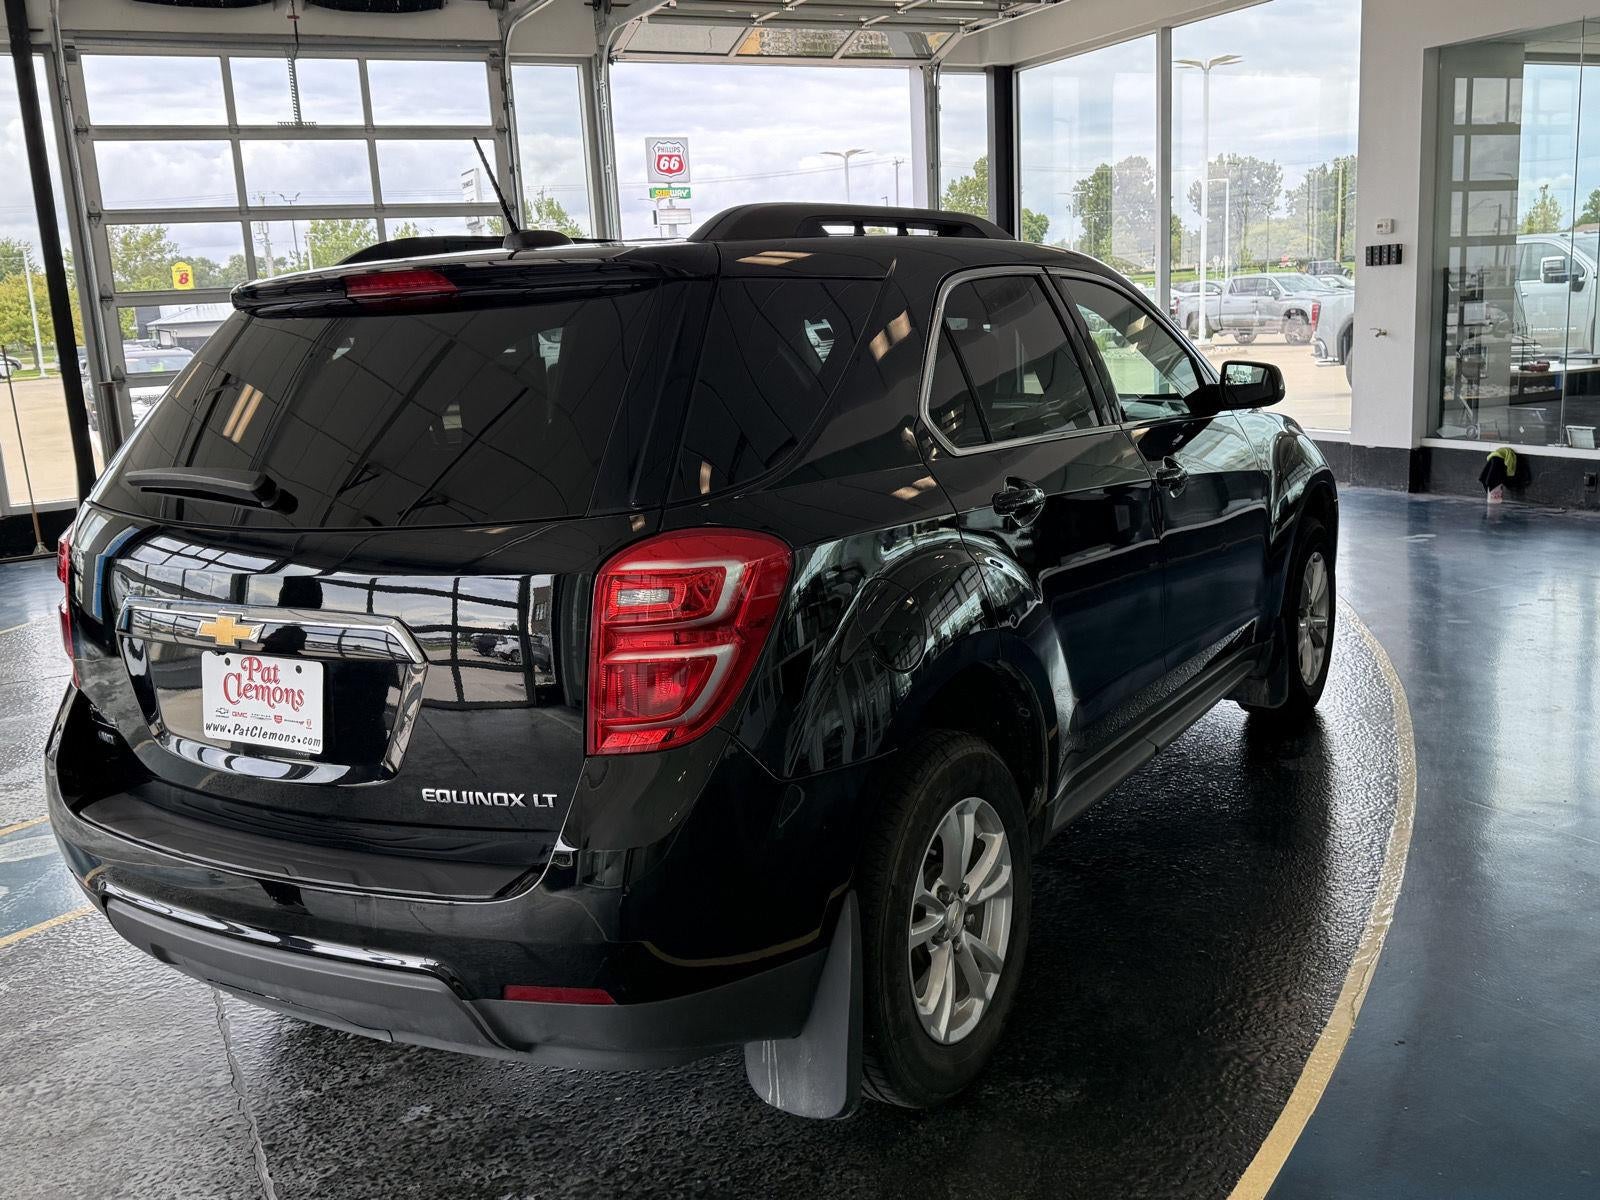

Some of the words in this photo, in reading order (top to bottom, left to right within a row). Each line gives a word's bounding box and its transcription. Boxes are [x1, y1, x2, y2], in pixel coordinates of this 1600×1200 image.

[660, 156, 680, 171] 66
[655, 189, 688, 197] SUBWAY
[179, 273, 189, 285] 8
[240, 656, 280, 685] Pat
[223, 672, 304, 712] Clemons
[231, 711, 248, 719] GMC
[205, 721, 321, 748] www.PatClemons.com
[421, 788, 527, 808] EQUINOX
[532, 793, 558, 808] LT
